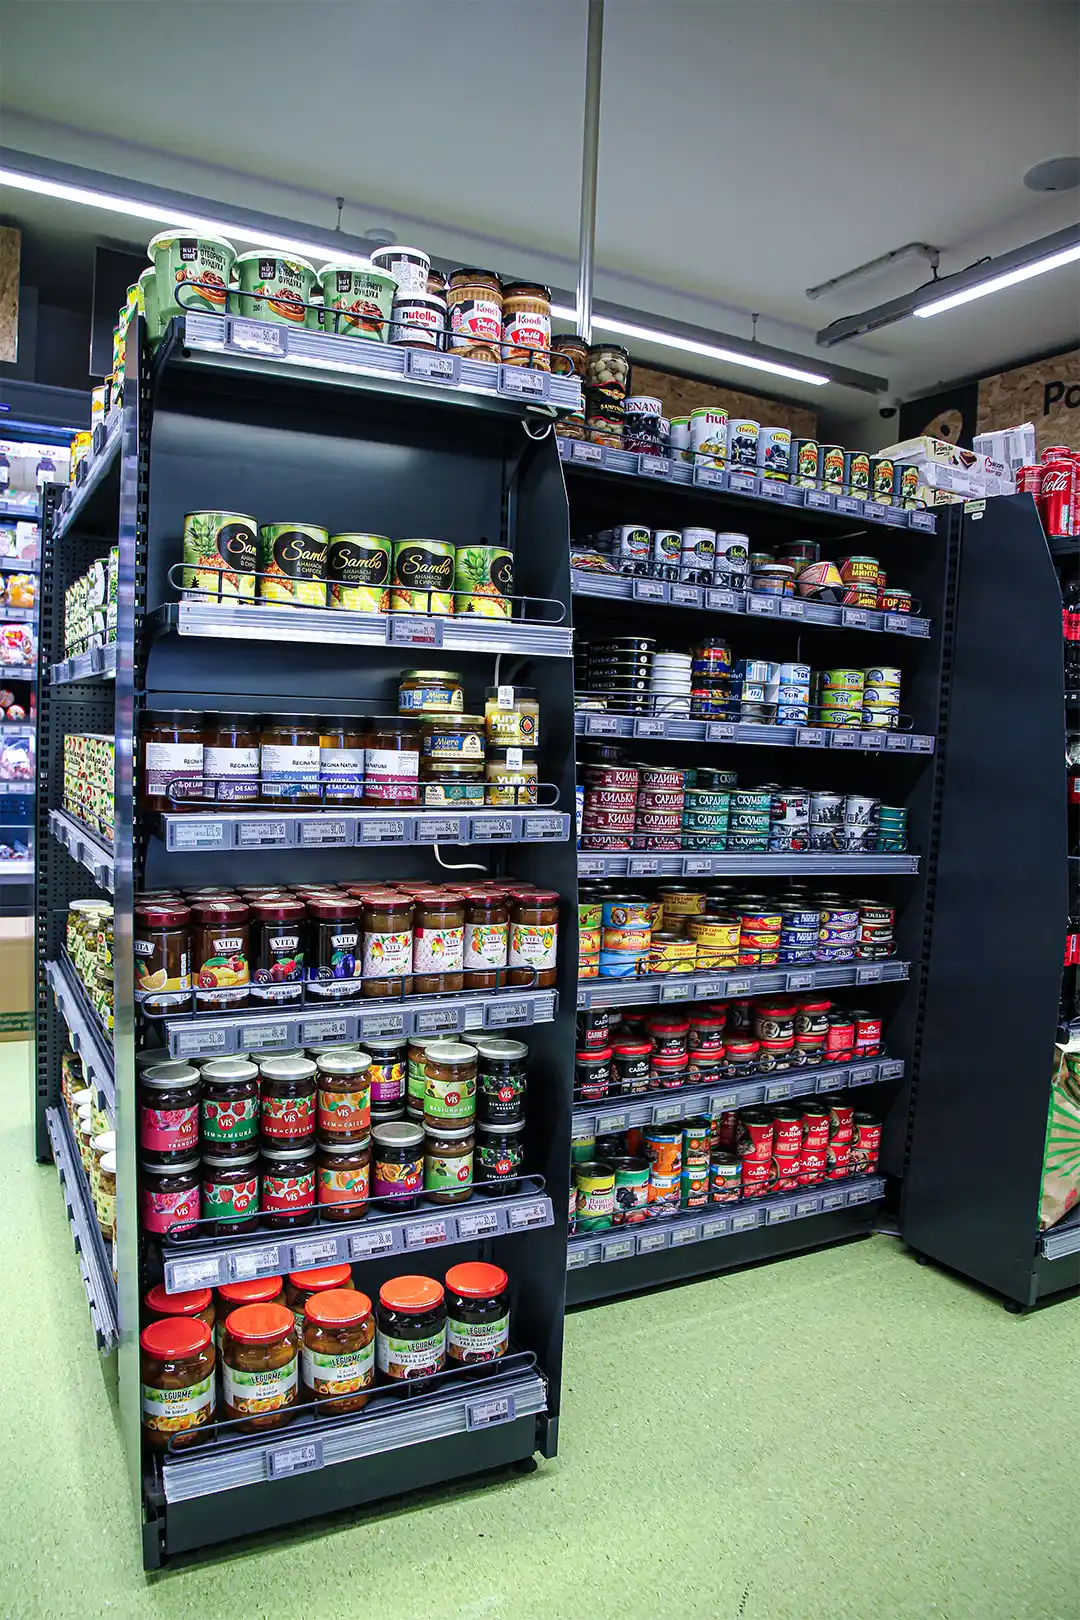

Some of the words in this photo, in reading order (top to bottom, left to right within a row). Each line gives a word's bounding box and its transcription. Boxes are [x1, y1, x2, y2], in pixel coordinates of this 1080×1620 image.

[402, 310, 437, 323] nutella
[1042, 471, 1072, 493] Cola
[332, 549, 382, 570] Sambo
[402, 555, 451, 575] Sambo
[428, 691, 449, 700] Miere
[784, 691, 799, 699] TON
[435, 738, 459, 746] Miere
[643, 772, 680, 784] САРДИНА
[643, 814, 679, 825] САРДИНА
[446, 1095, 459, 1104] VIS
[500, 1090, 512, 1099] VIS
[336, 1108, 349, 1117] VIS
[219, 1117, 233, 1127] VIS
[283, 1113, 297, 1123] VIS
[181, 1123, 192, 1133] VIS
[498, 1162, 510, 1171] VIS
[458, 1169, 469, 1178] VIS
[405, 1176, 417, 1186] VIS
[353, 1183, 364, 1193] VIS
[285, 1193, 298, 1202] VIS
[236, 1198, 248, 1208] VIS
[176, 1205, 189, 1216] VIS
[465, 1325, 496, 1336] LEGURME
[407, 1340, 436, 1352] LEGURME
[331, 1353, 361, 1366] LEGURME
[251, 1370, 282, 1383] LEGURME
[159, 1389, 193, 1402] LEGURME
